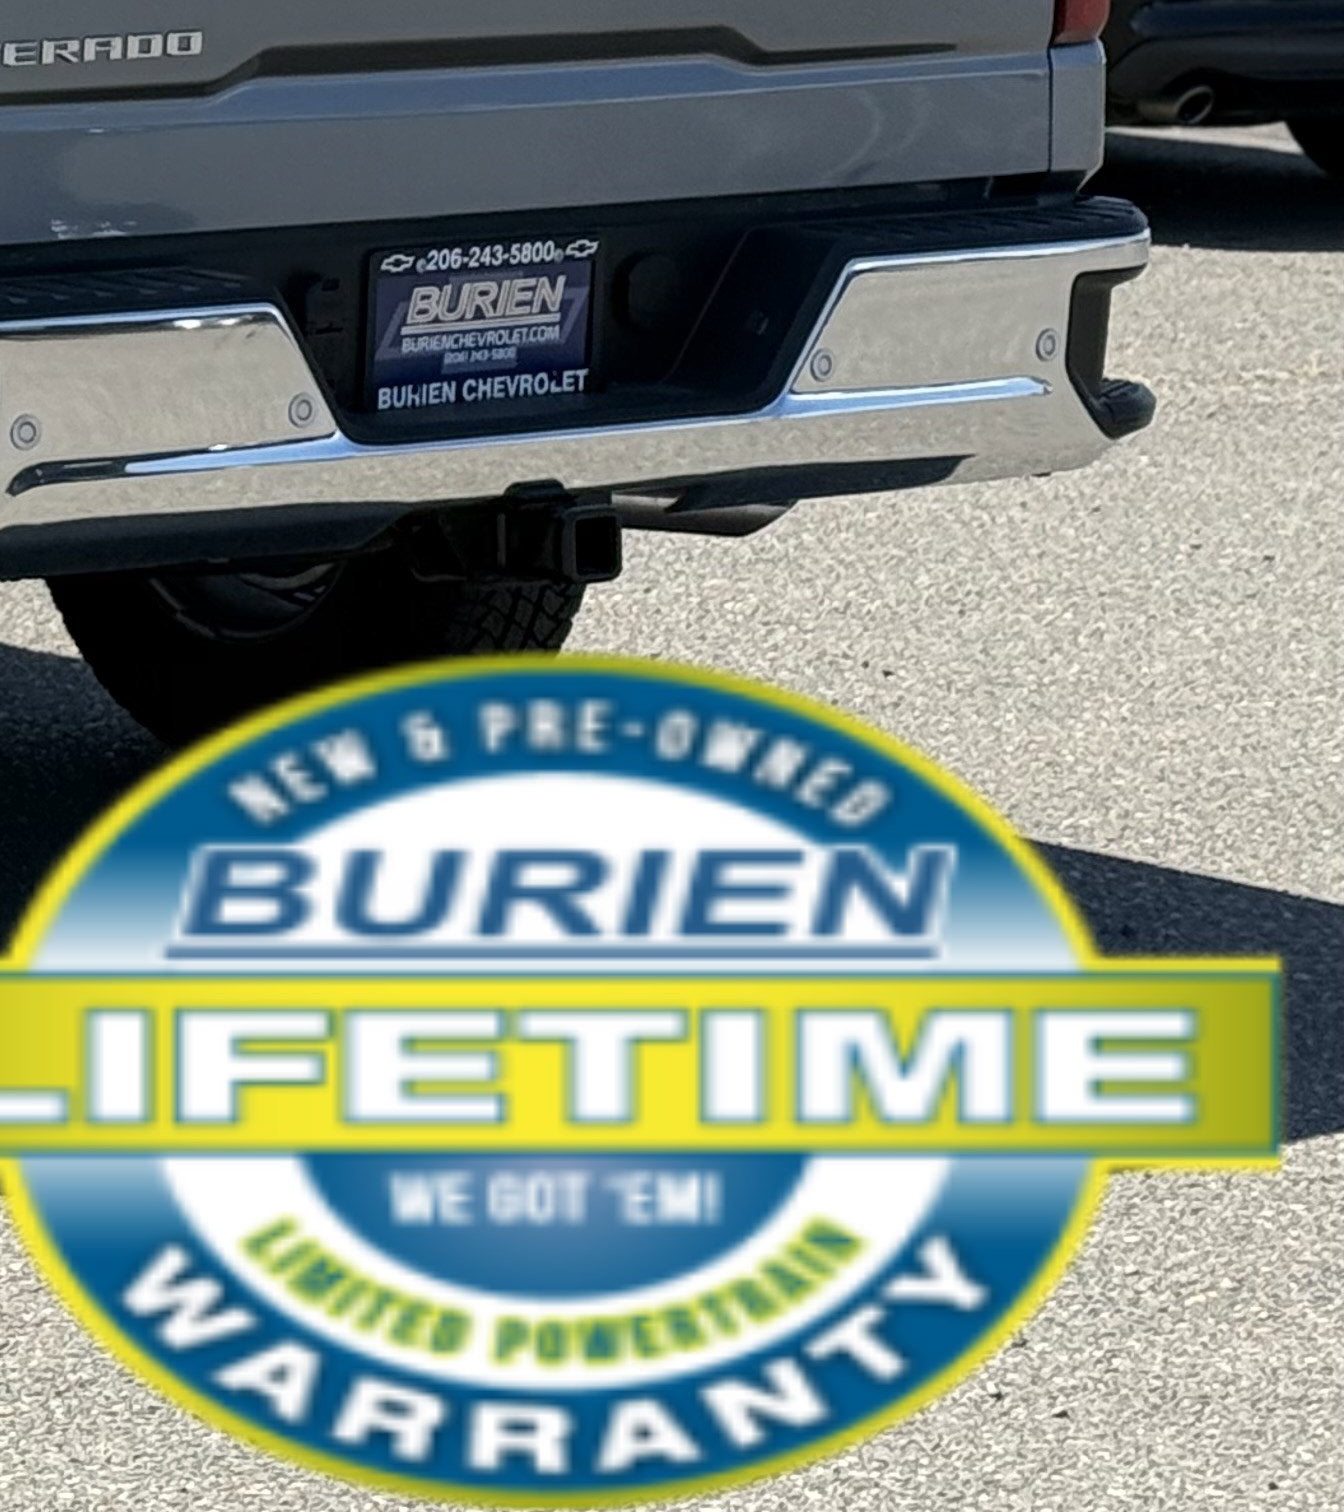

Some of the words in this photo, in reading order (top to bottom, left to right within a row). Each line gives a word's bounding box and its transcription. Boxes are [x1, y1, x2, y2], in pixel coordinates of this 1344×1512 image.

[426, 240, 556, 271] 206-243-5800
[406, 274, 567, 325] BURIEN
[401, 325, 561, 354] BURIENCHEVROLET.COM
[377, 381, 456, 410] BURIEN
[462, 368, 589, 402] CHEVROLET
